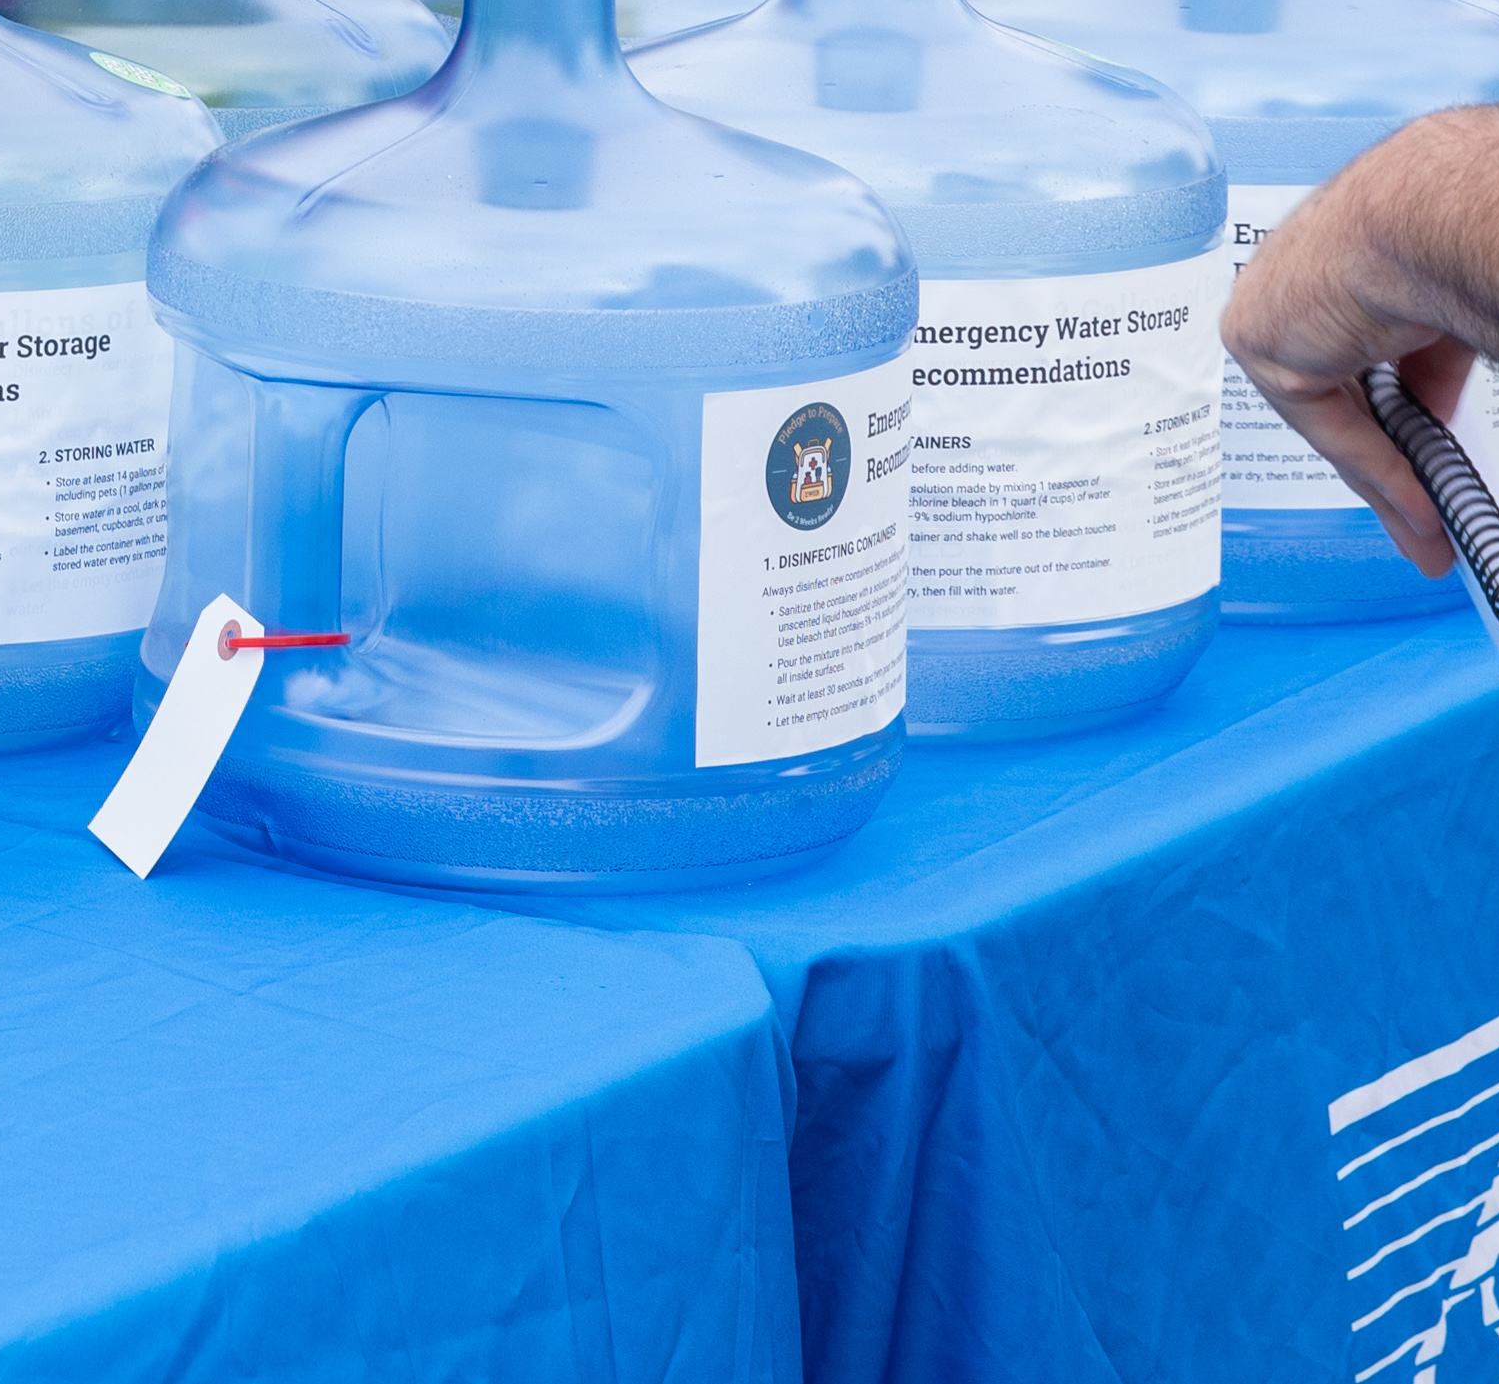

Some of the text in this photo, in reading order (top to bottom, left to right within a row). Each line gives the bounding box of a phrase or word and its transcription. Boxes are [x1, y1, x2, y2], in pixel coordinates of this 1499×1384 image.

[916, 306, 1188, 349] mergency Water Storage
[17, 335, 110, 359] Storage
[913, 356, 1130, 386] ecommendations
[778, 413, 806, 445] Pledge
[808, 409, 817, 418] to
[1144, 404, 1210, 435] 2. STORING WATER
[39, 439, 154, 464] 2. STORING WATER
[764, 523, 896, 570] 1. DISINFECTING CONTAINERS
[922, 585, 1018, 597] then fill with water.
